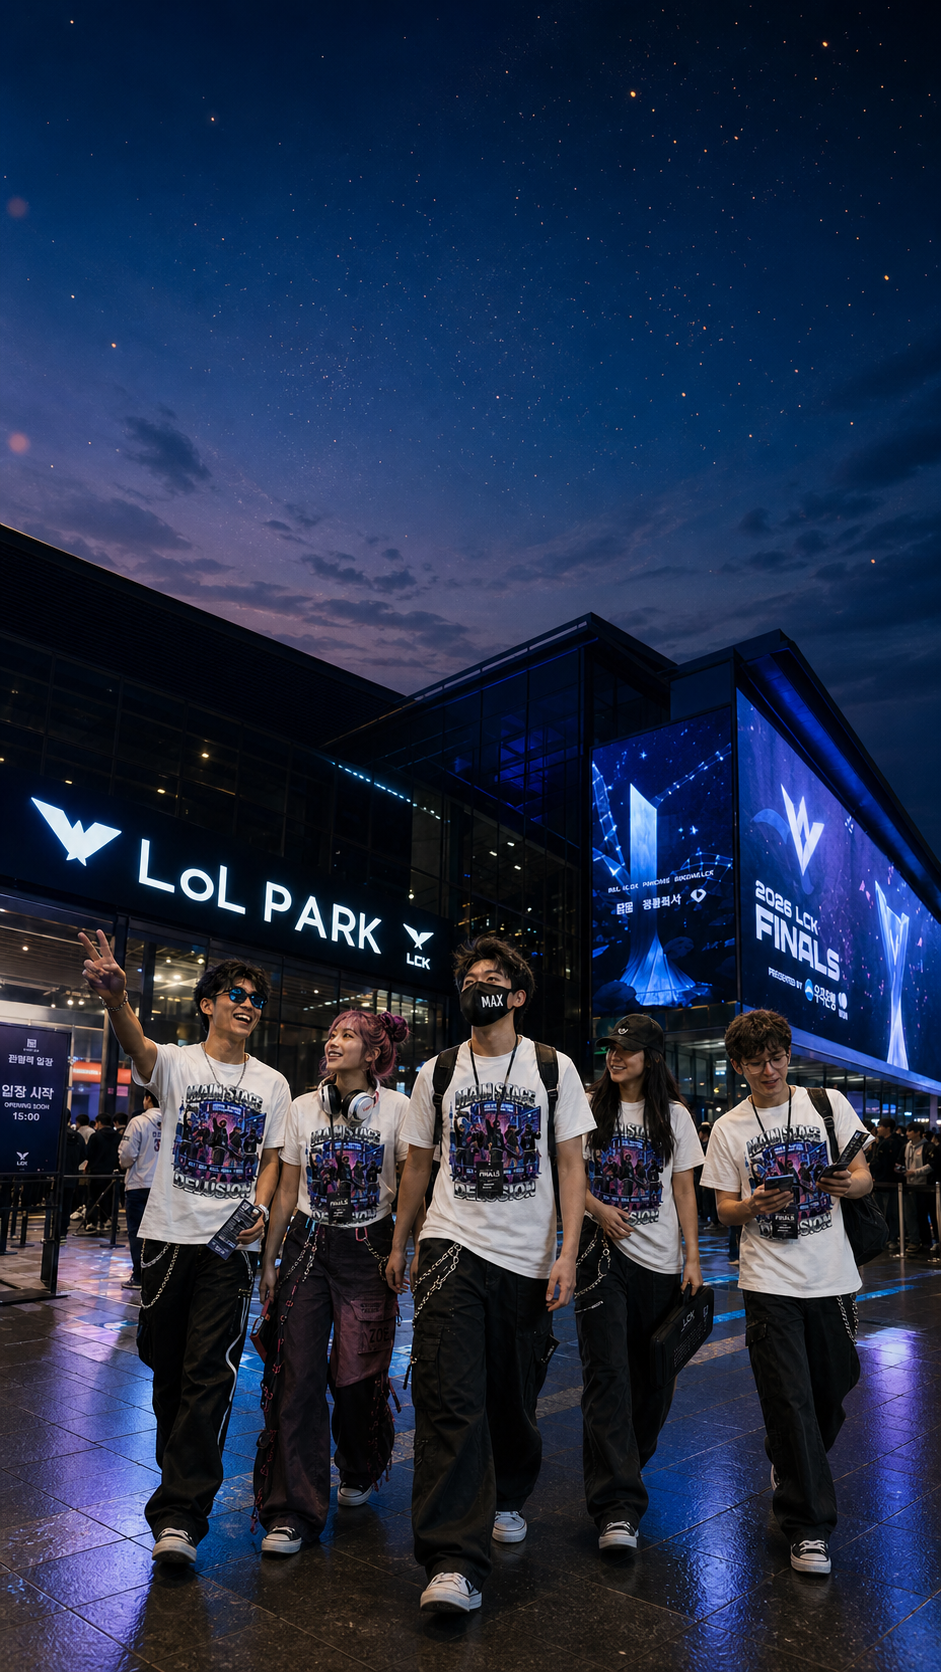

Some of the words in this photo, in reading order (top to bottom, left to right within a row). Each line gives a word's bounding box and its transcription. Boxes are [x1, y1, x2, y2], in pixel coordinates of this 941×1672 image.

[139, 838, 246, 915] LoL
[264, 881, 382, 954] PARK
[755, 880, 792, 918] 2026
[796, 905, 819, 936] LCK
[756, 903, 840, 981] FINALS
[406, 952, 431, 970] LCK
[481, 994, 504, 1008] MAX
[2, 1084, 27, 1099] 입장
[30, 1086, 55, 1100] 시작
[186, 1083, 223, 1103] MAIN
[455, 1083, 494, 1110] MAIN
[13, 1112, 40, 1121] 15:00
[173, 1171, 251, 1200] DELUSION
[370, 1327, 390, 1343] ZOE
